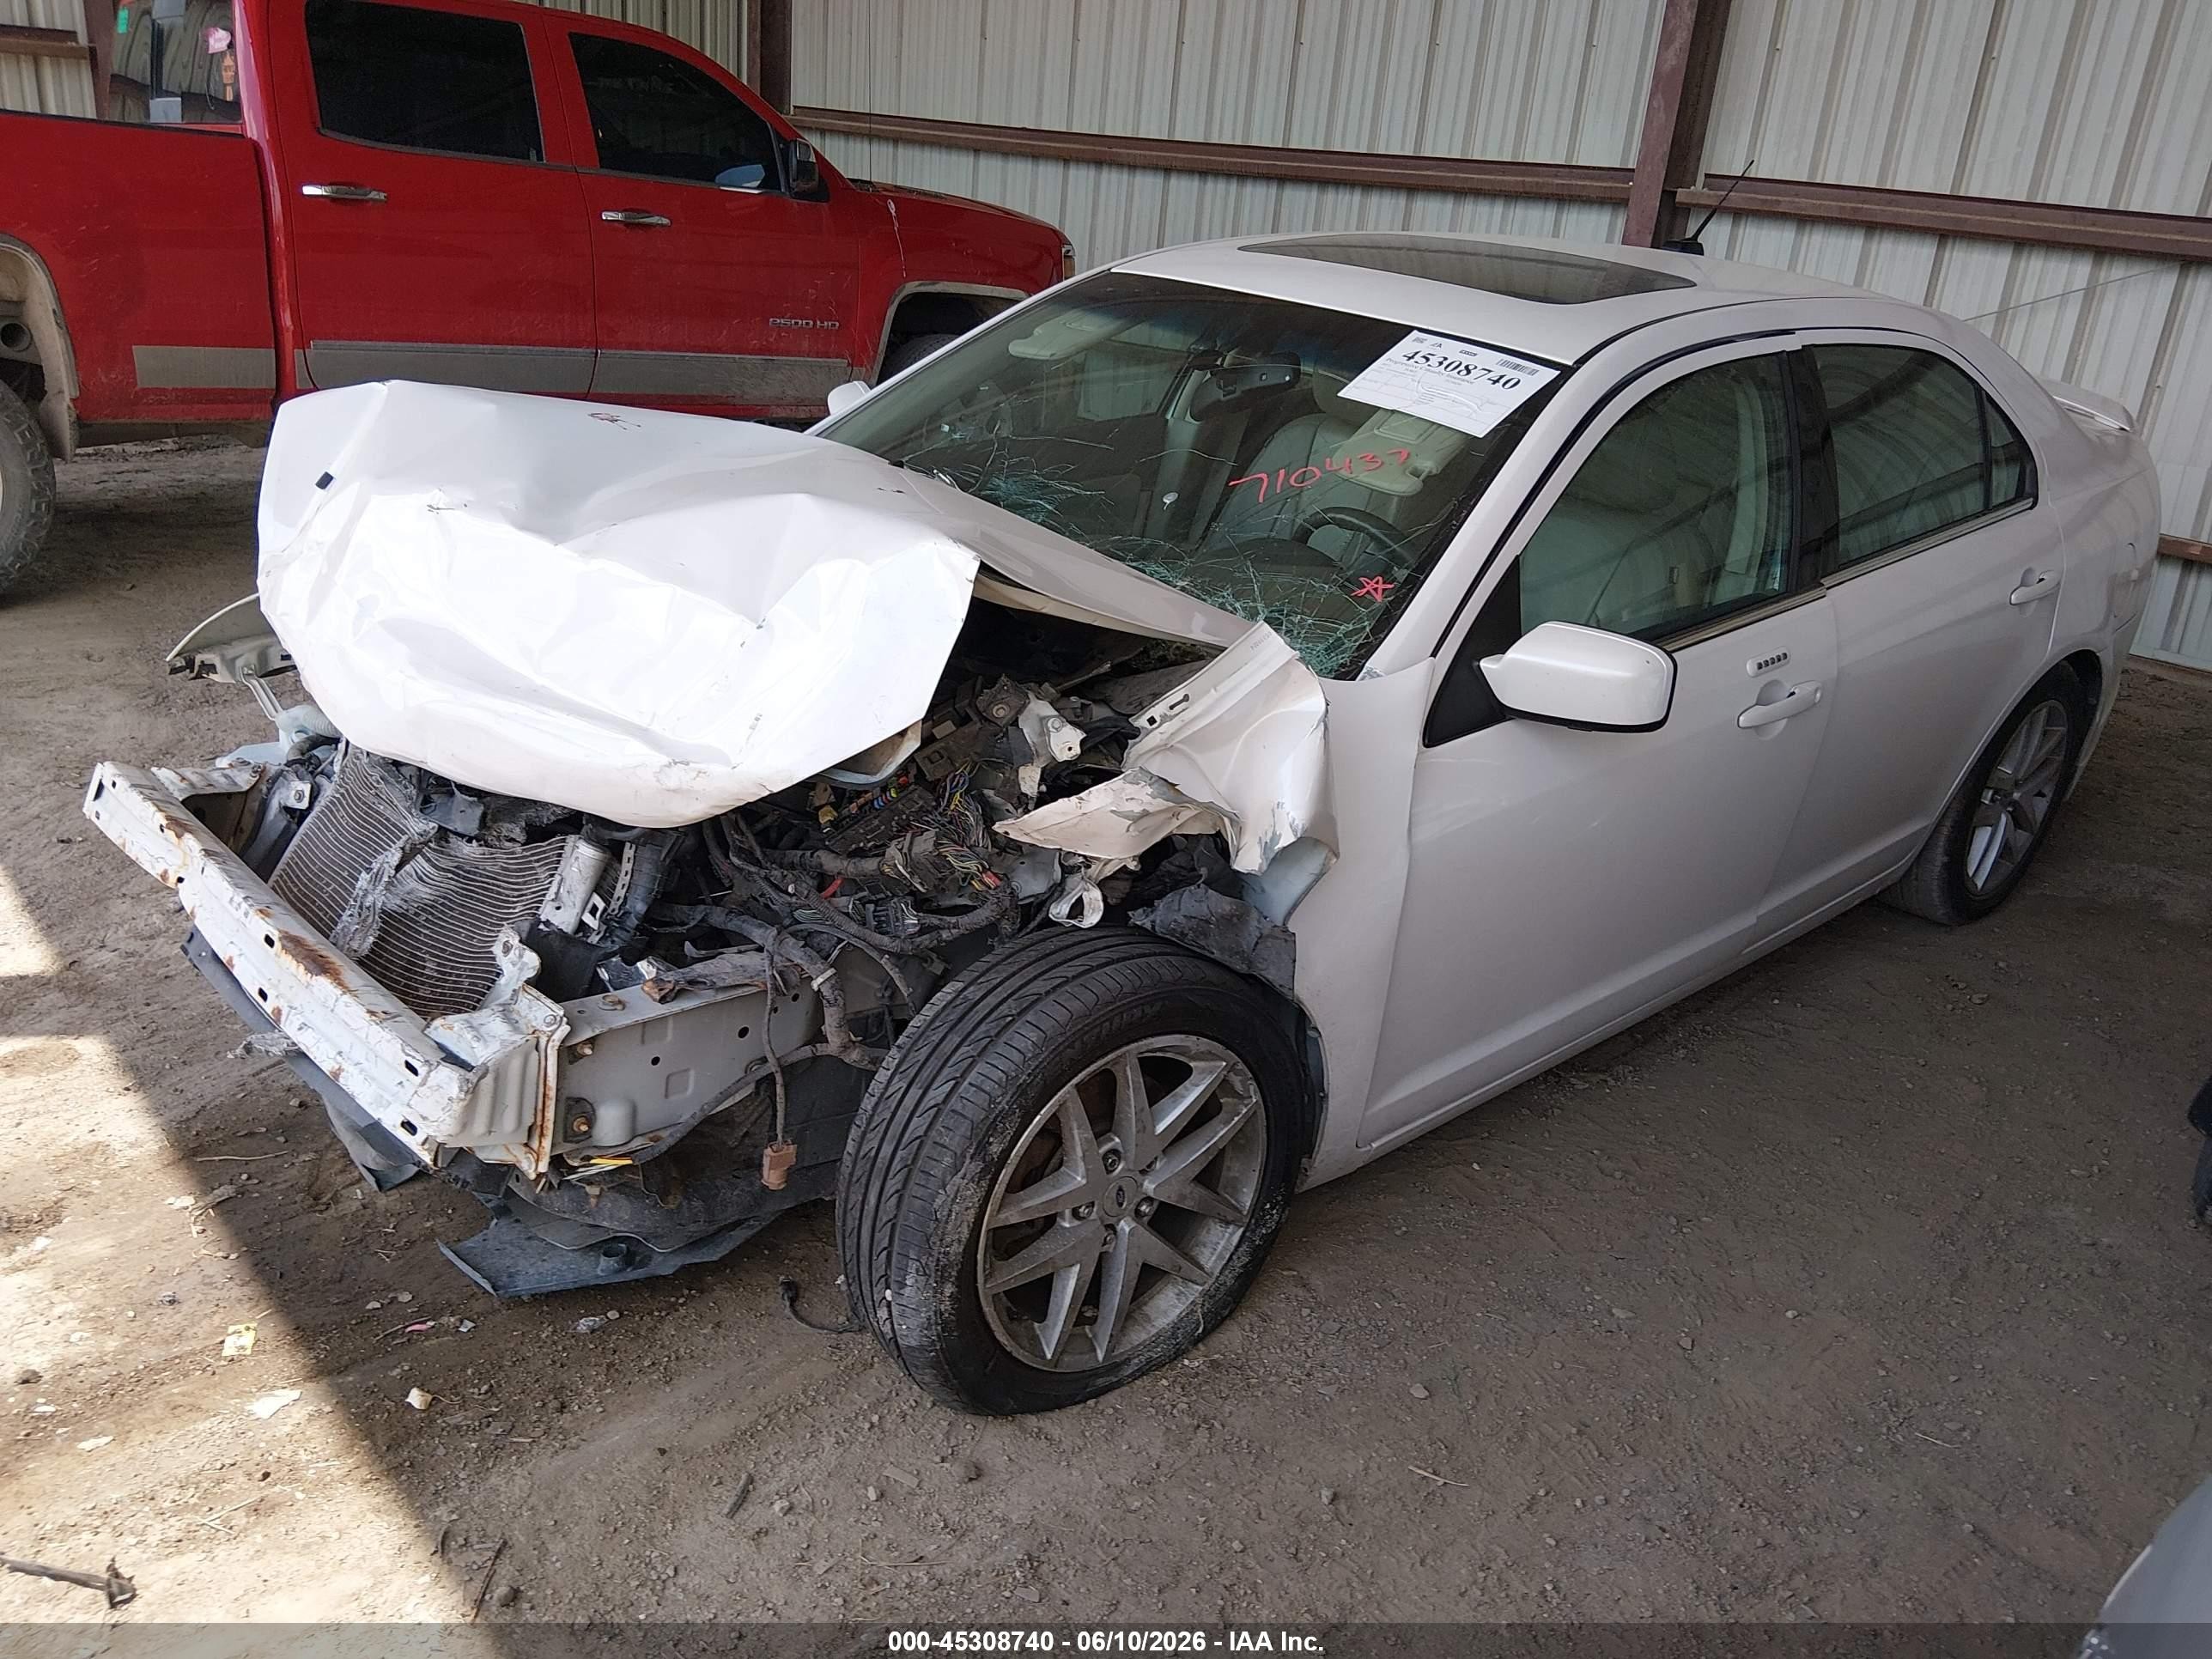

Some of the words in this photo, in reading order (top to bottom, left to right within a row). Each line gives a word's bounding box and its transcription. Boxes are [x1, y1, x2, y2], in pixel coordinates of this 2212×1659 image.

[769, 318, 813, 329] 2500
[817, 320, 839, 330] HD
[1401, 349, 1522, 391] 45308740
